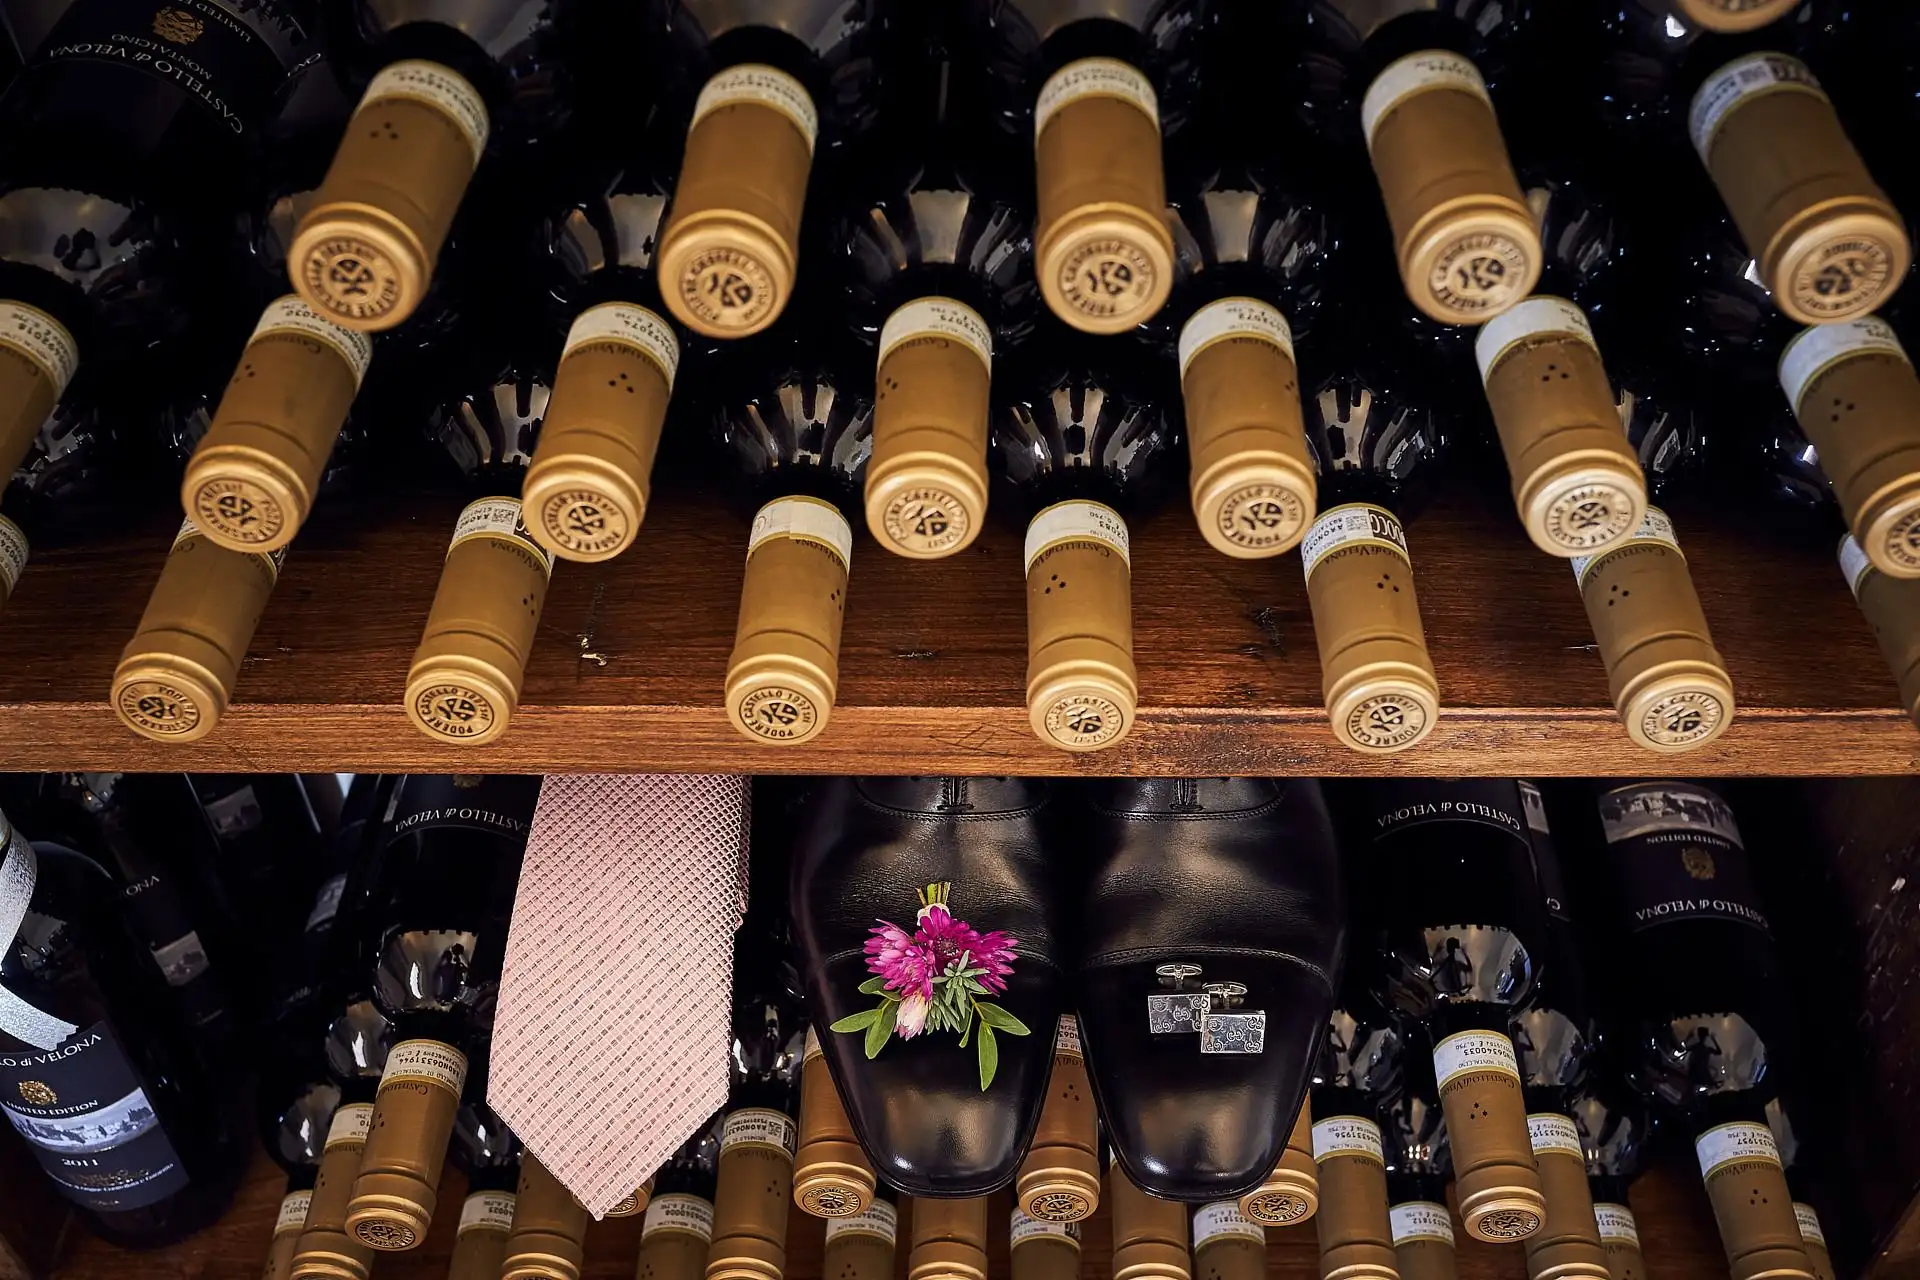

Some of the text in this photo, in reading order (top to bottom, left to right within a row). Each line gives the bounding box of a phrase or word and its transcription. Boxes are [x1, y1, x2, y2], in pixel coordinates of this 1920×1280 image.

[196, 1, 252, 43] LIMITED
[111, 33, 213, 80] MONTALCINO
[50, 43, 244, 134] CASTELLO di VELONA
[1055, 542, 1111, 558] CASTELLO
[1323, 546, 1370, 565] VELONA
[418, 687, 458, 714] CASTELLO
[742, 690, 782, 718] CASTELLO
[423, 717, 476, 735] PODERE
[745, 720, 795, 738] PODERE
[1349, 703, 1372, 744] CASTELLO
[1372, 725, 1420, 745] PODERE
[395, 809, 440, 833] VELONA
[443, 808, 457, 818] di
[1377, 801, 1521, 831] CASTELLO di VELONA
[1645, 833, 1731, 850] LIMITED EDITION
[1635, 899, 1769, 929] CASTELLO di VELONA
[20, 1057, 32, 1067] di
[35, 1034, 102, 1064] VELONA
[1472, 1075, 1515, 1090] CASTELLO
[6, 1099, 99, 1116] LIMITED EDITION
[61, 1157, 99, 1167] 2011
